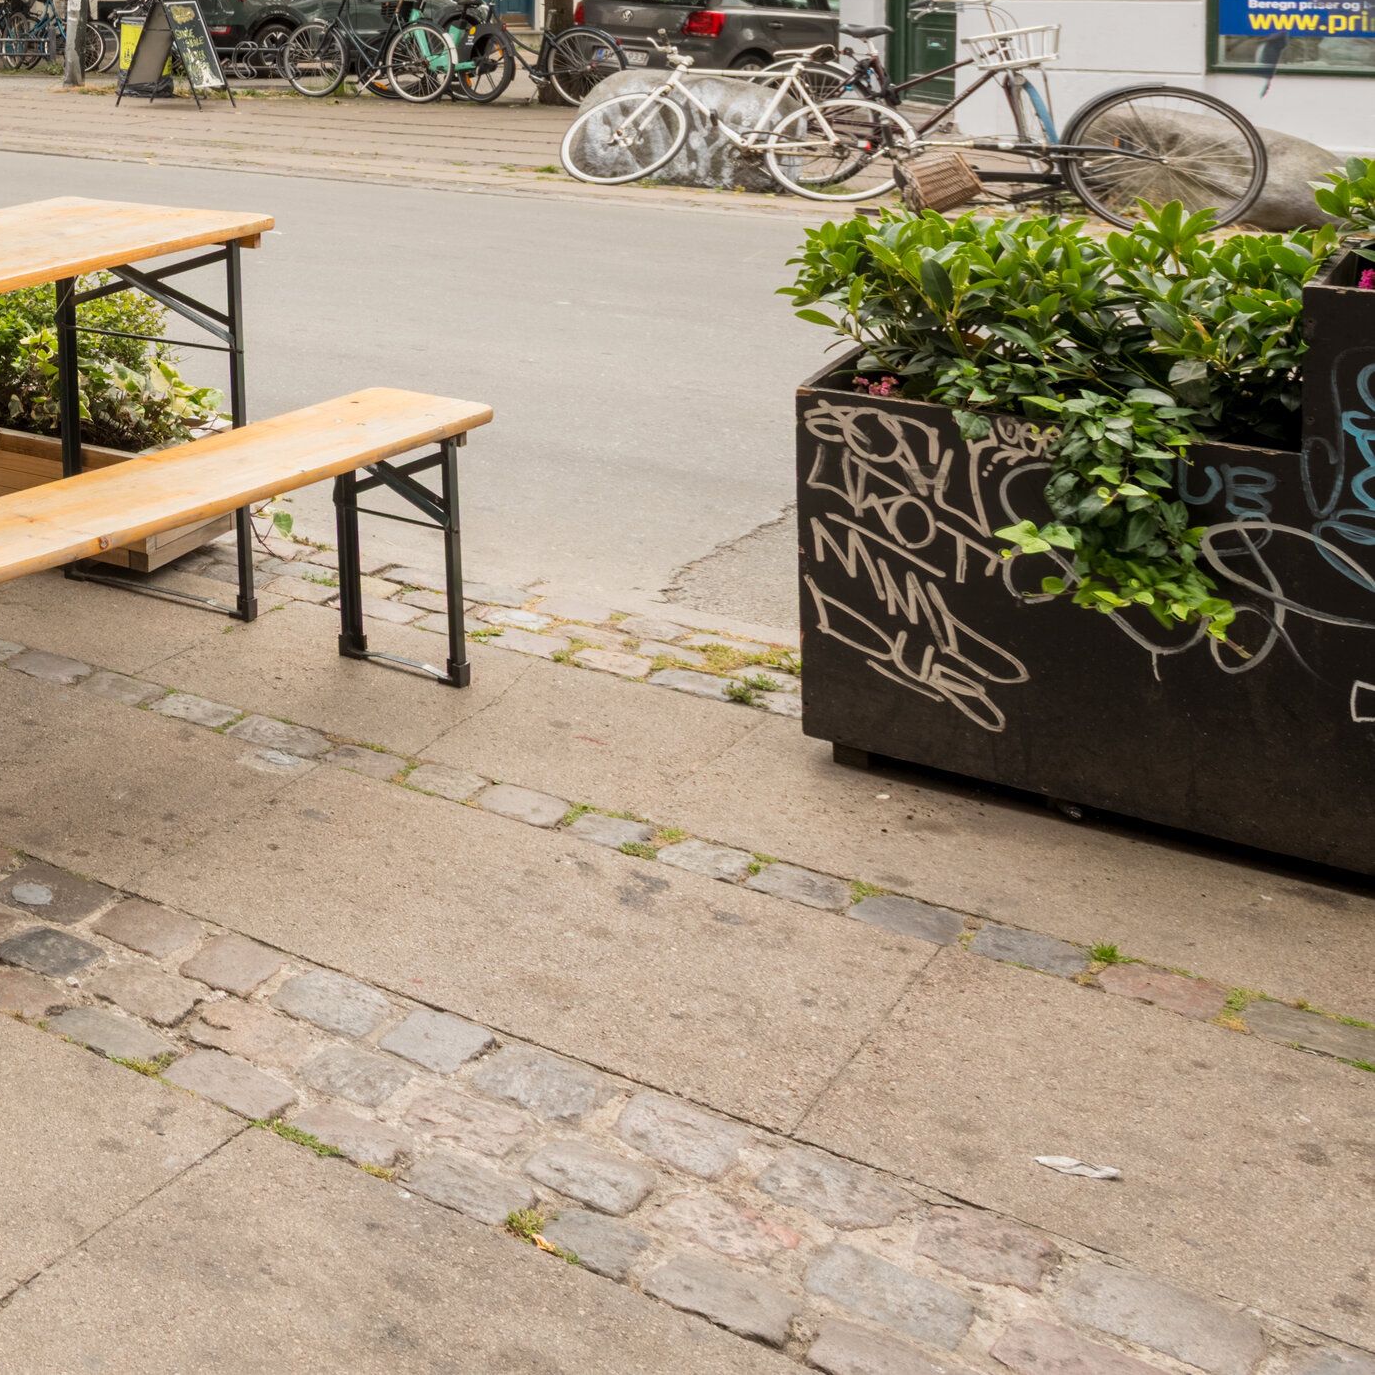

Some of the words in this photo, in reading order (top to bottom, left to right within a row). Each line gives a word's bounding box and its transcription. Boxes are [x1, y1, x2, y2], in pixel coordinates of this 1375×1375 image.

[1248, 0, 1297, 11] Beregn
[1298, 0, 1340, 11] priser
[1342, 0, 1360, 12] og
